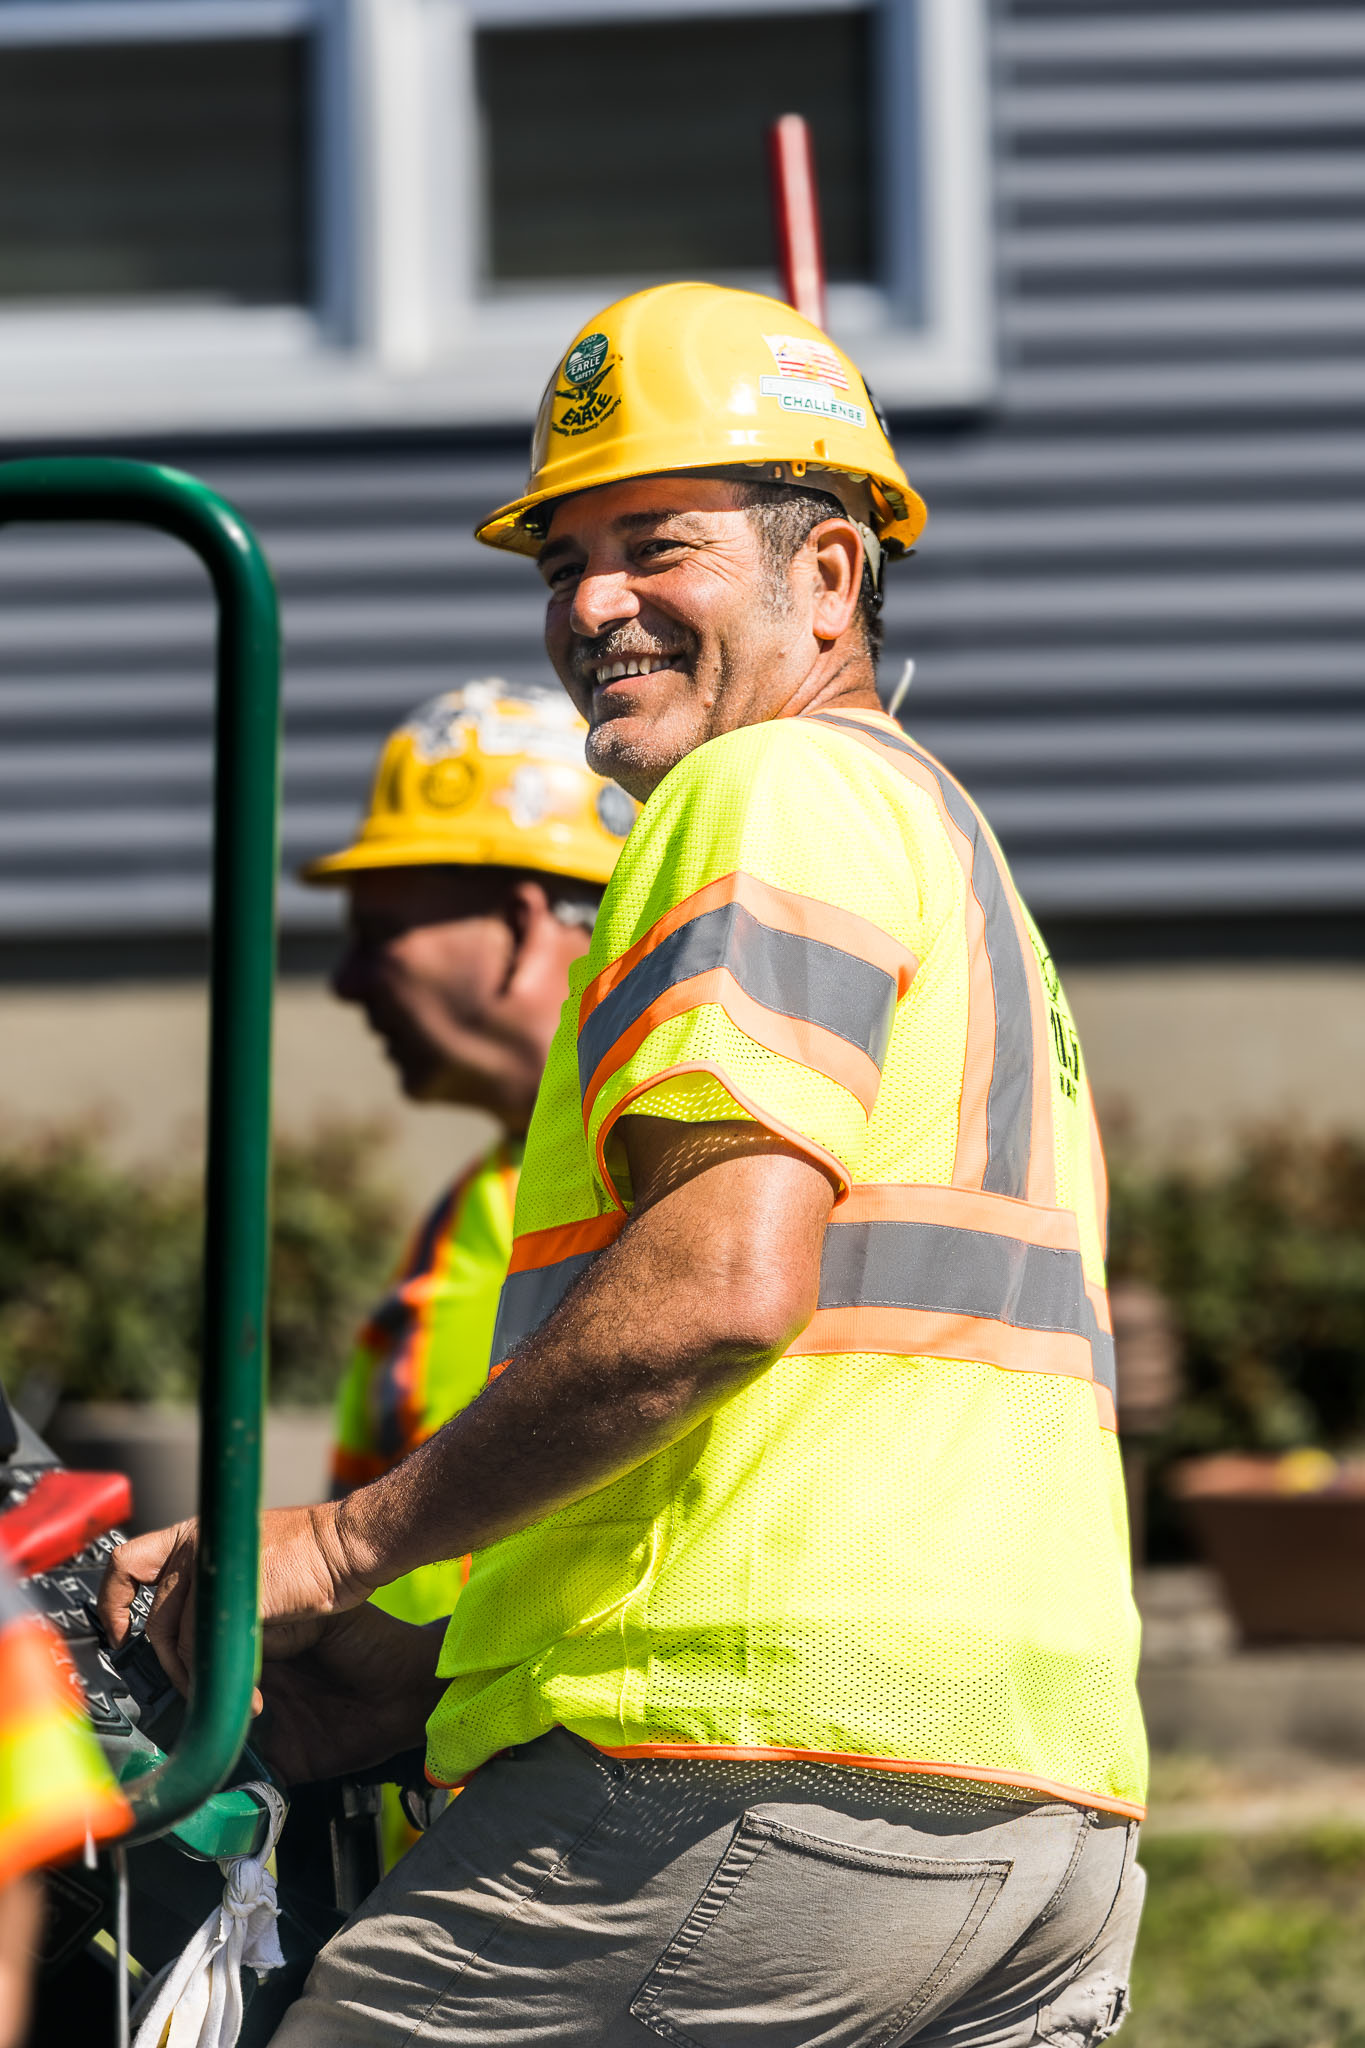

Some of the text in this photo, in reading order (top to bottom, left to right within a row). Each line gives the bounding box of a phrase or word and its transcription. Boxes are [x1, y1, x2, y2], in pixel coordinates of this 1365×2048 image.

[571, 355, 601, 375] EARLE
[574, 368, 596, 381] SAFETY
[560, 393, 613, 426] EARLE
[783, 396, 862, 421] CHALLENGE
